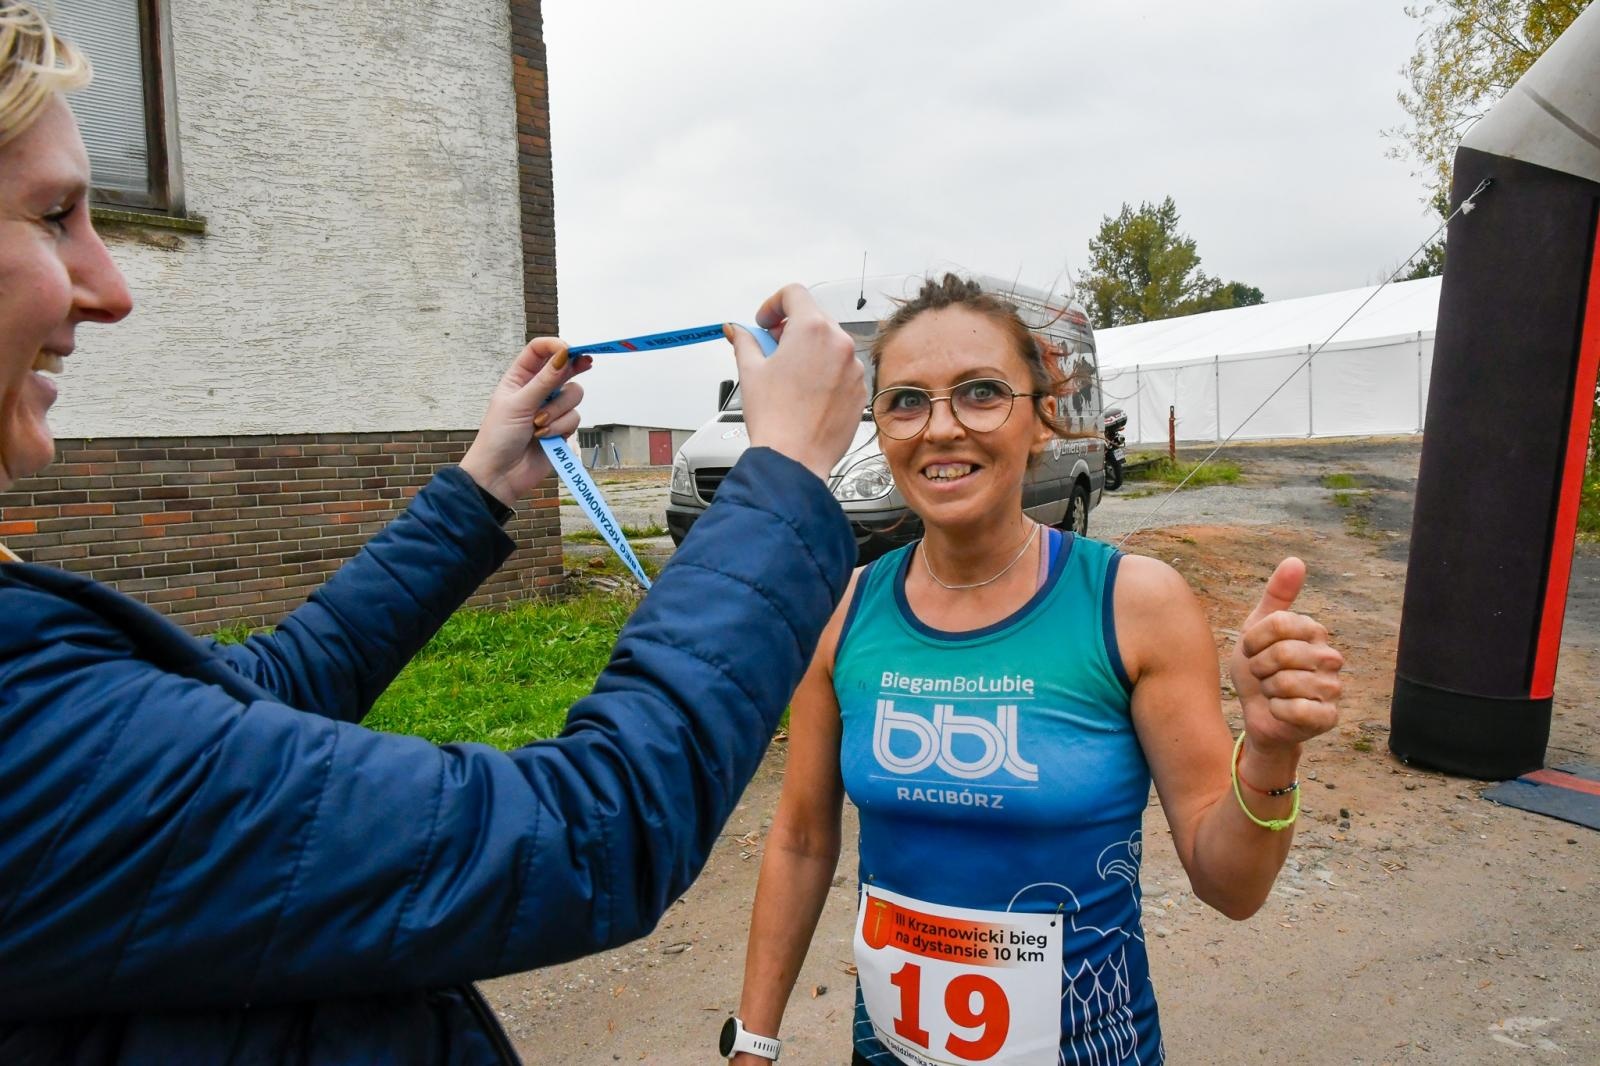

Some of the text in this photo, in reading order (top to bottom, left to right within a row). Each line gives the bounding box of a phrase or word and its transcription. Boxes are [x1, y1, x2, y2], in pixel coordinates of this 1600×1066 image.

[552, 446, 568, 463] KM
[563, 460, 574, 474] 10
[572, 474, 622, 545] KRZANOWICKI
[620, 543, 637, 570] BIEG
[880, 671, 1035, 695] BiegamBoLubię
[872, 699, 1039, 782] bbl
[896, 786, 1004, 809] RACIBÓRZ
[895, 912, 1048, 949] III Krzanowicki bieg
[895, 929, 1045, 962] na dystansie 10 km
[890, 962, 1011, 1062] 19
